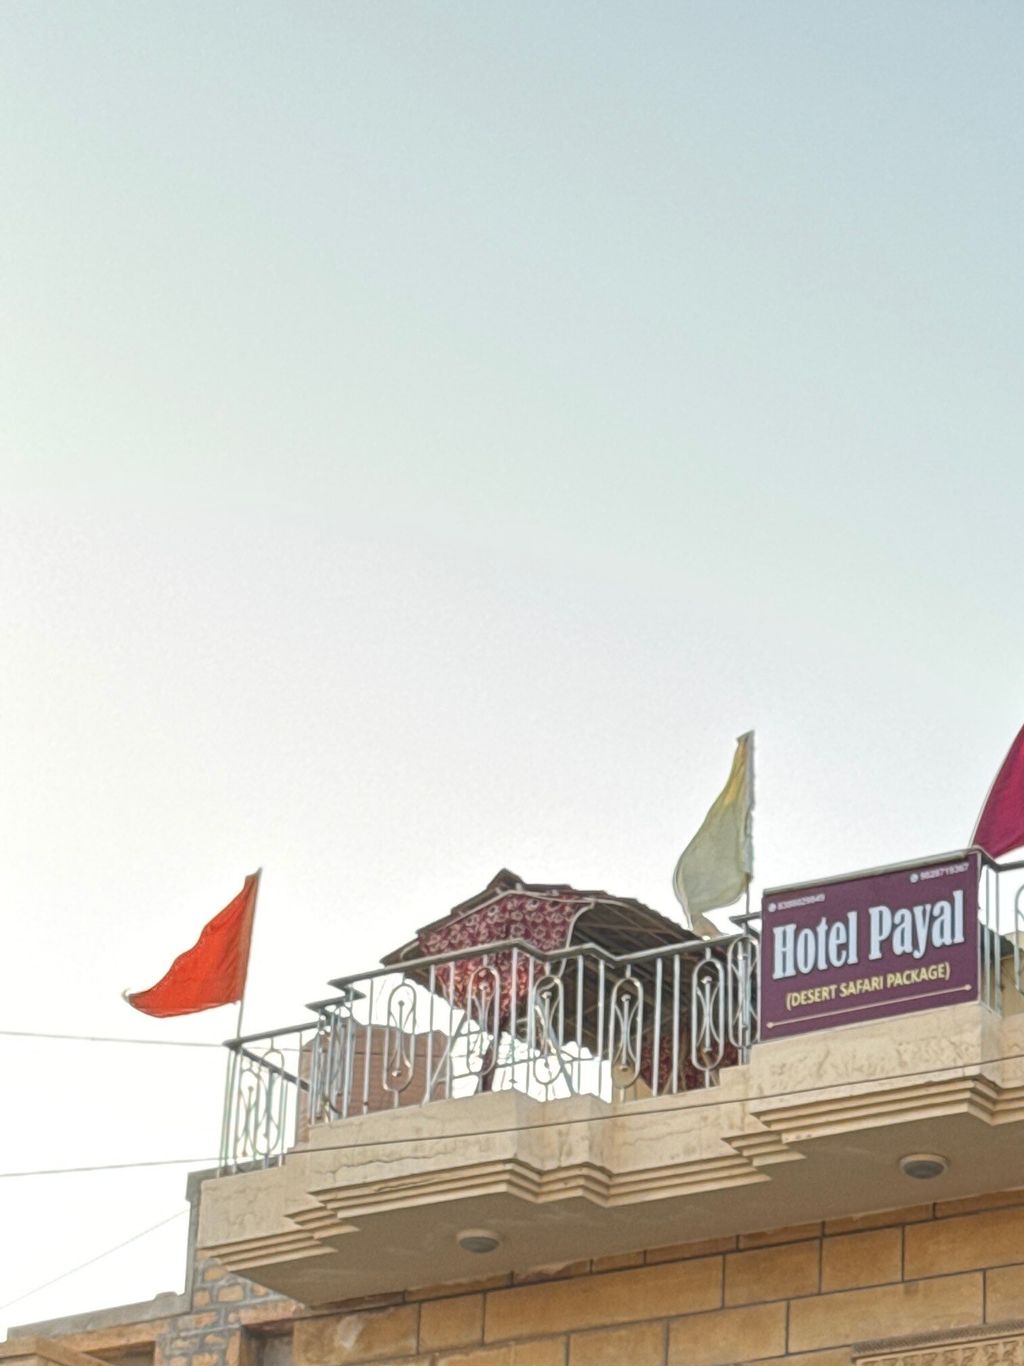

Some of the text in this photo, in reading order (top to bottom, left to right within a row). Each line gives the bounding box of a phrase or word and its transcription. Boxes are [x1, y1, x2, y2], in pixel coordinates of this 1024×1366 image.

[772, 889, 965, 980] Hotel Payal
[785, 962, 951, 1011] (DESERT SAFARI PACKAGE)
